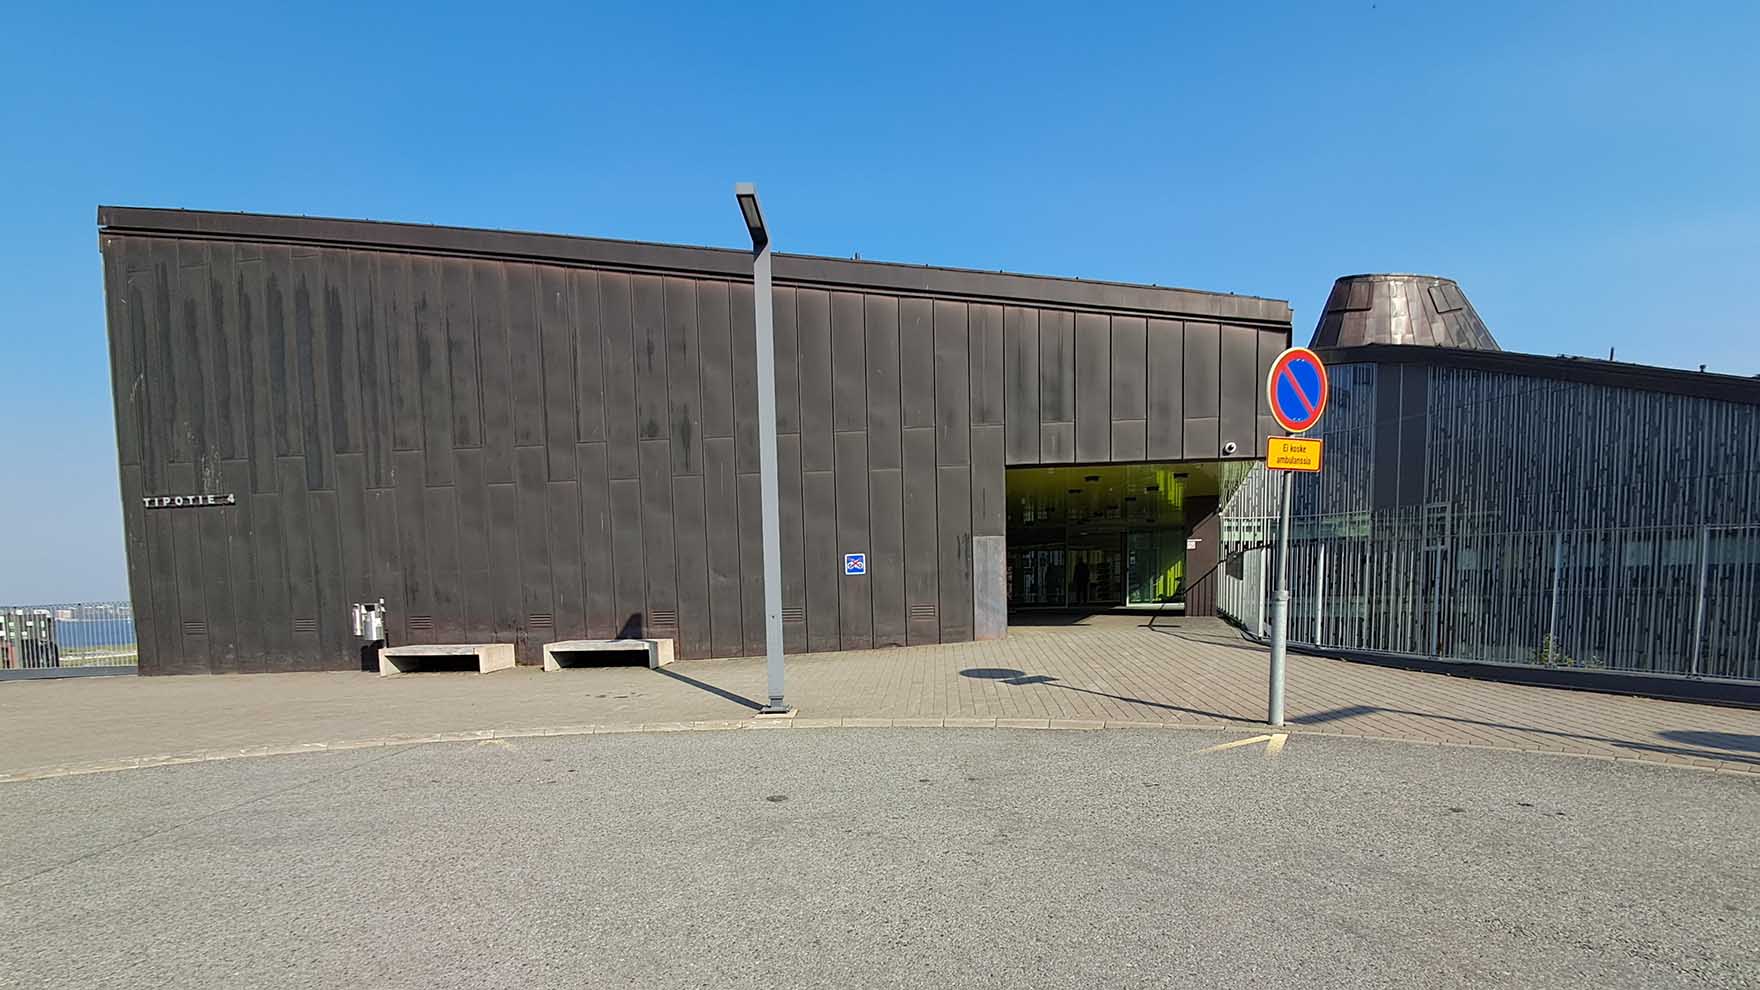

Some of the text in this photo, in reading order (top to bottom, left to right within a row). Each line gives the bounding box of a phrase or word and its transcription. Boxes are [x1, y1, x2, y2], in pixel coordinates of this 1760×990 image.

[1283, 443, 1306, 453] Ei koske
[1276, 456, 1311, 465] ambulanssia
[143, 493, 235, 507] TIPOTIE 4
